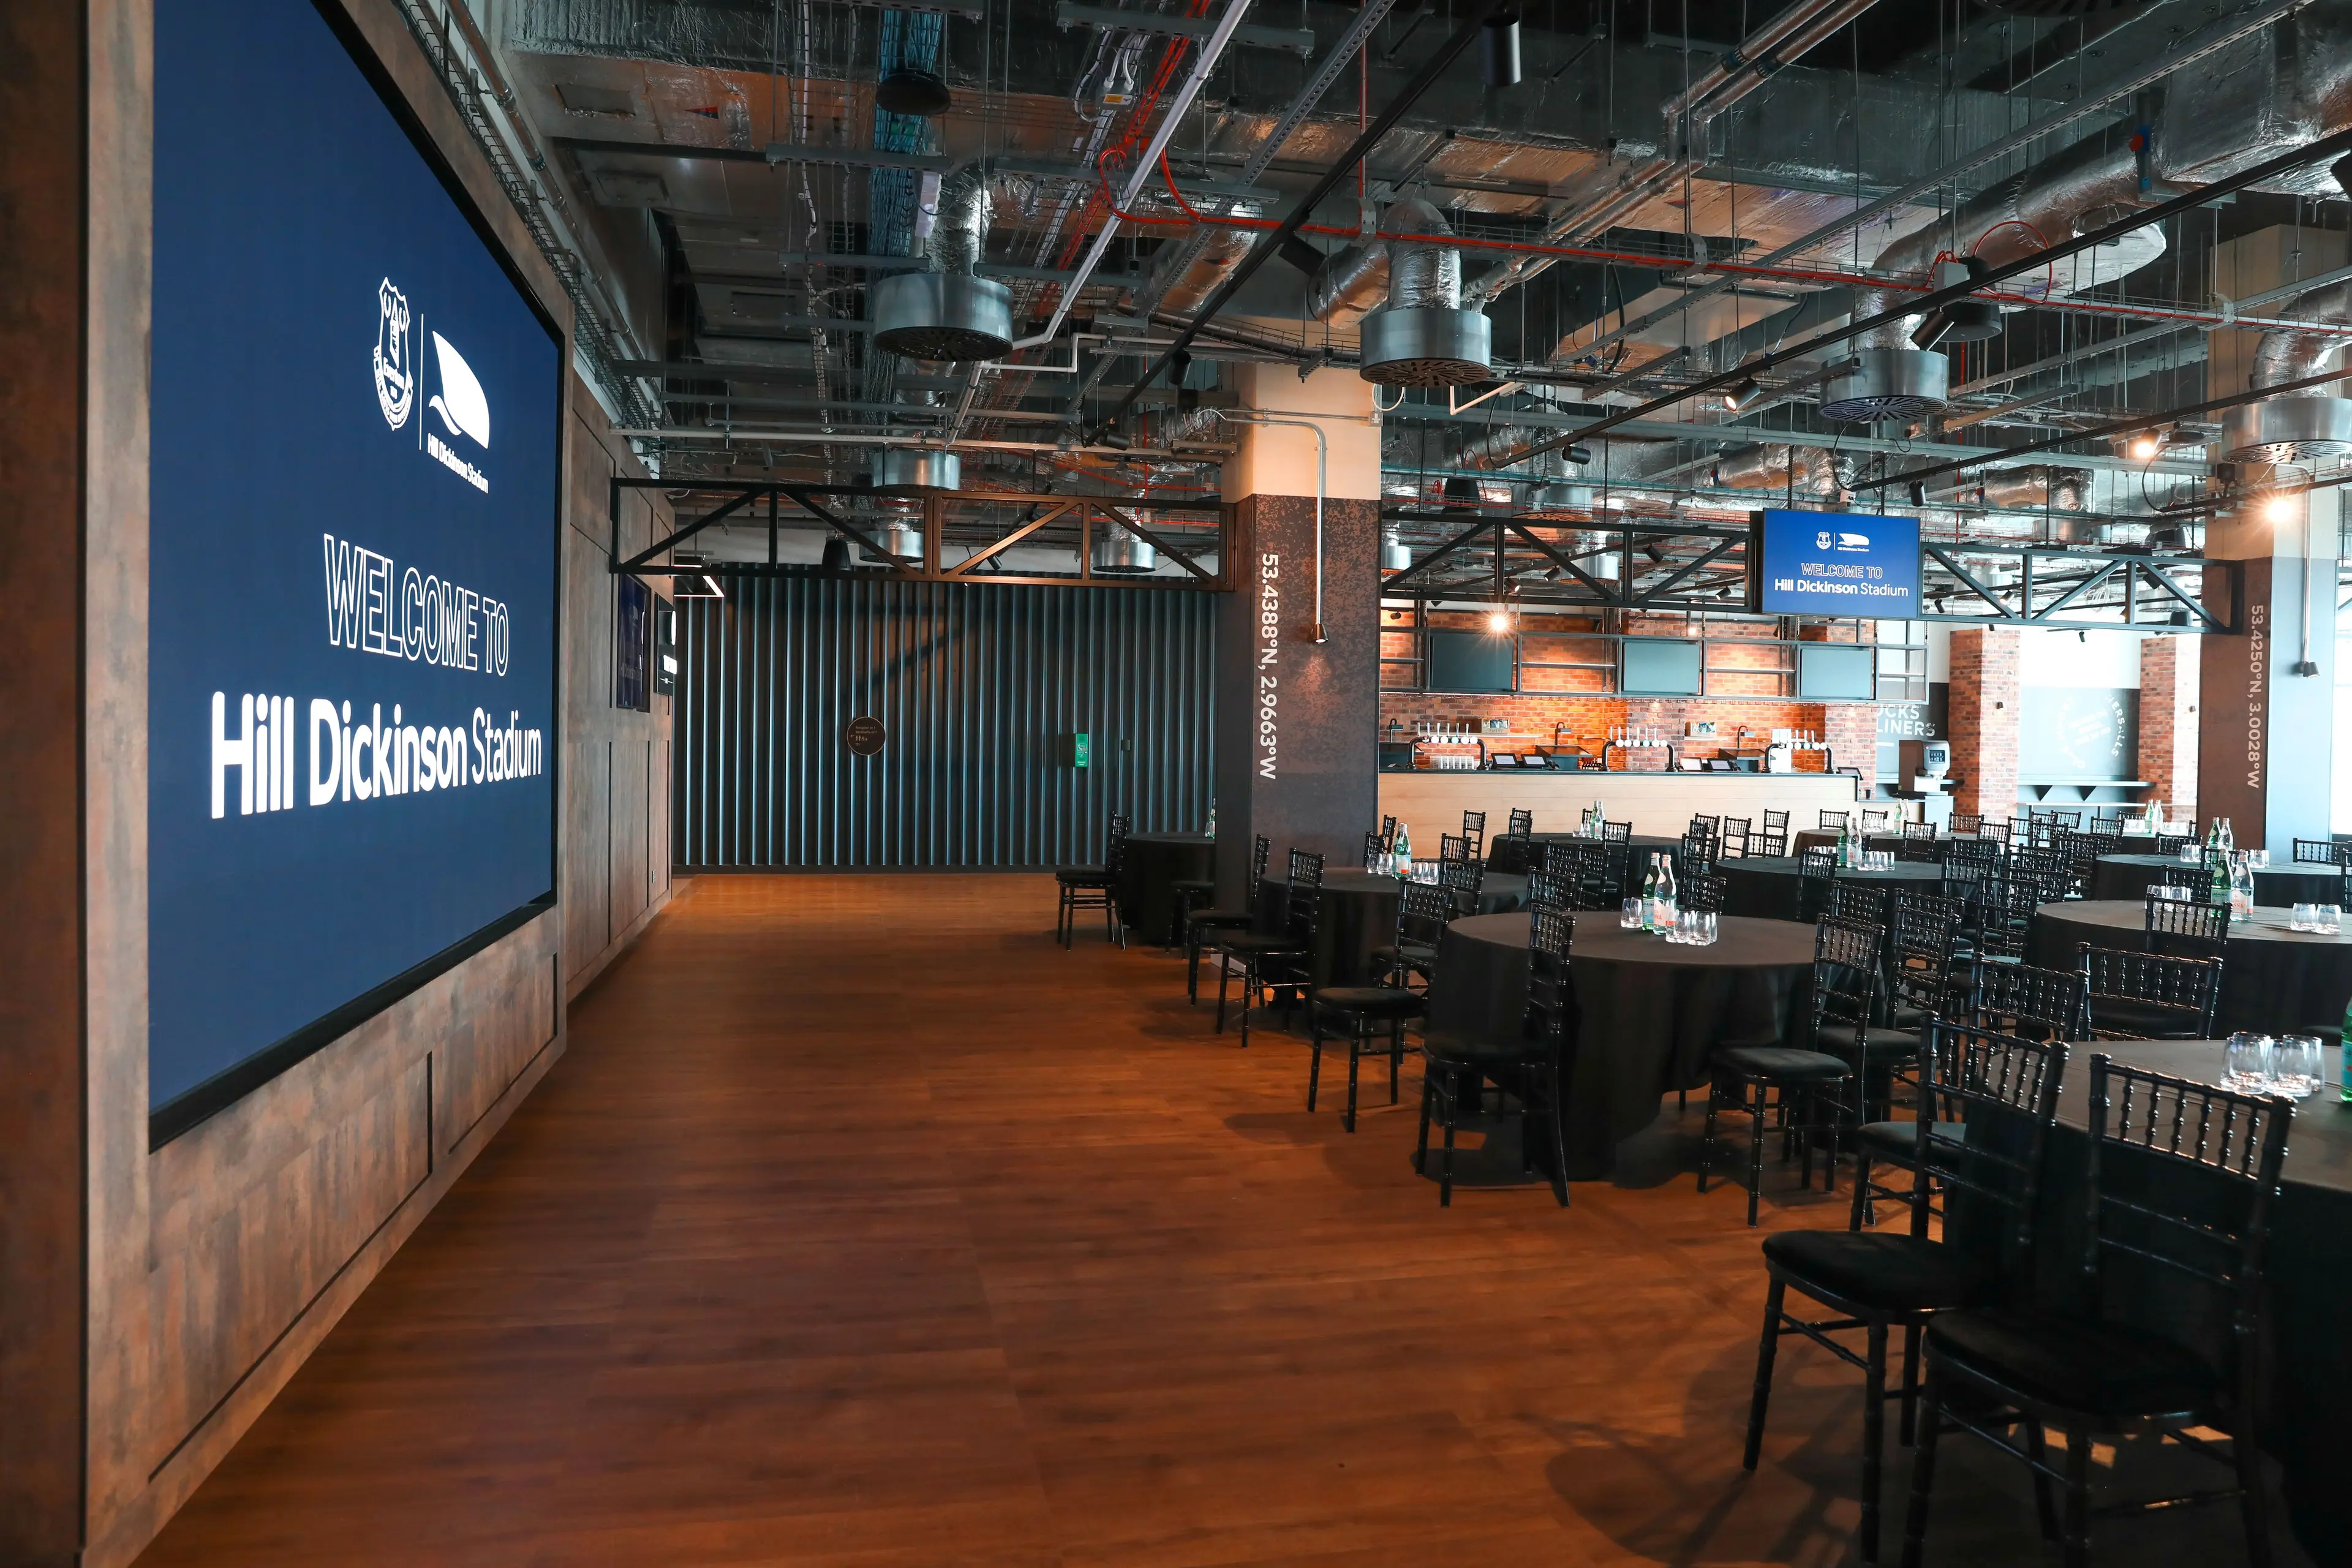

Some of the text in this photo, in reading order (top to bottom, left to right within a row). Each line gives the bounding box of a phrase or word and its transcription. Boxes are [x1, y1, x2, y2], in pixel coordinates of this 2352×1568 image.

[324, 533, 509, 677] WELCOME TO
[1774, 578, 1909, 597] Hill Dickinson Stadium
[1801, 562, 1883, 579] WELCOME TO
[1257, 553, 1279, 780] 53.4388°N, 2.9663°W
[2247, 605, 2264, 789] 53.4250°N, 3.0028°W
[211, 691, 541, 819] Hill Dickinson Stadium
